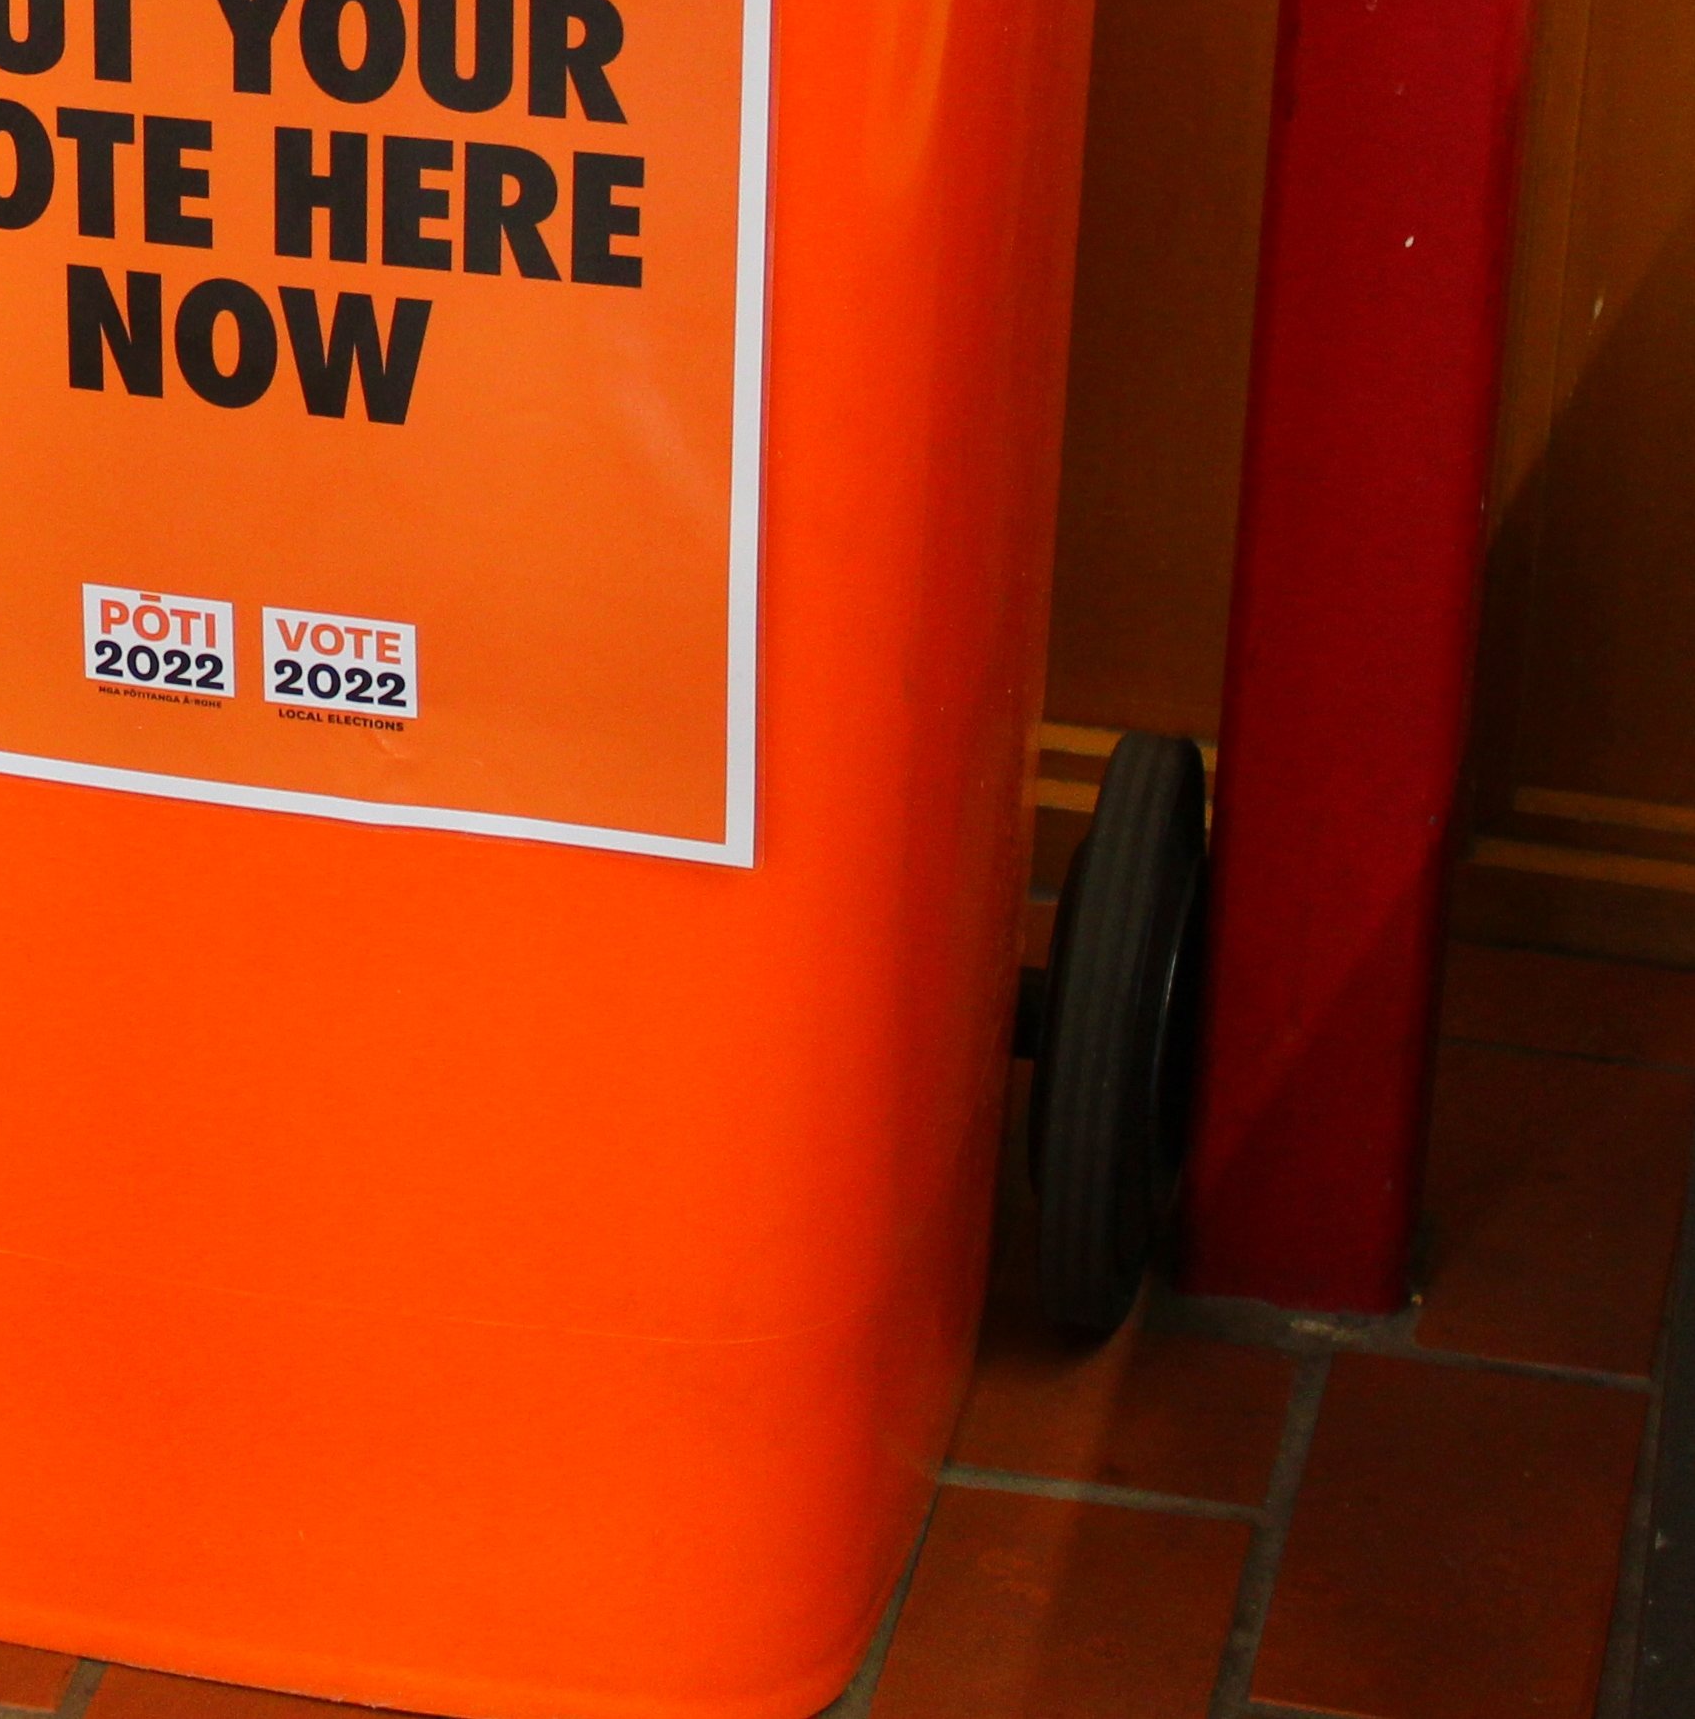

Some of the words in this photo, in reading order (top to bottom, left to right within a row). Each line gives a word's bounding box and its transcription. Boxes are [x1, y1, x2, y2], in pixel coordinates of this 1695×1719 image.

[274, 126, 645, 288] HERE
[66, 263, 433, 425] NOW
[100, 593, 217, 649] PŌTI
[275, 618, 402, 665] VOTE
[94, 640, 225, 691] 2022
[98, 685, 121, 695] NGA
[274, 659, 407, 708] 2022
[278, 708, 324, 723] LOCAL
[328, 713, 404, 732] ELECTIONS
